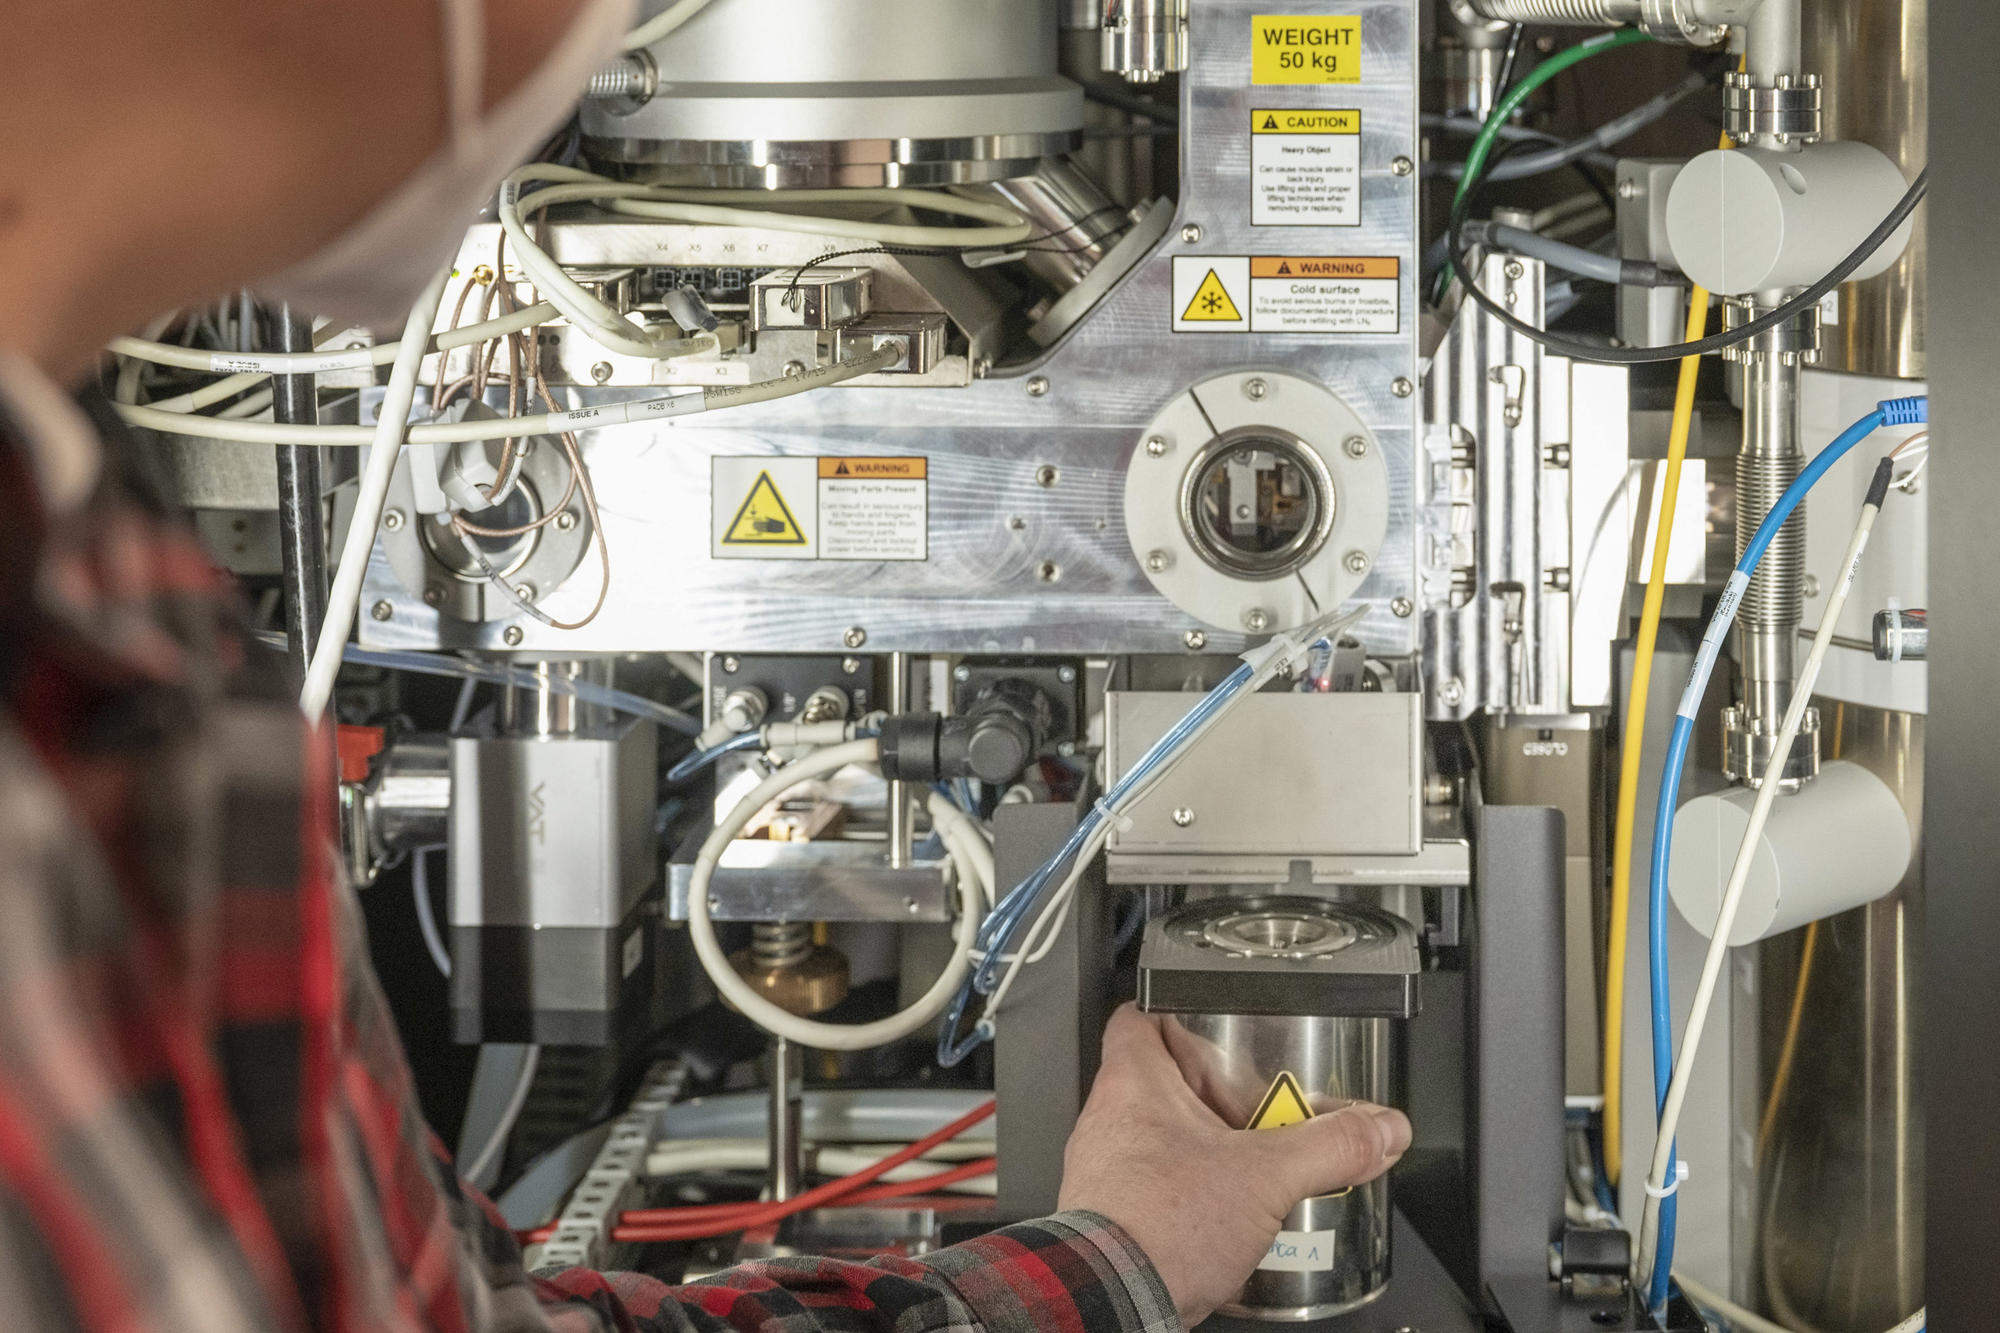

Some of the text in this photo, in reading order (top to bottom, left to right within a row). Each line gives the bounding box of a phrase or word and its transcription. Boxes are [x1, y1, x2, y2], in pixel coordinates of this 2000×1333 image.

[1263, 28, 1354, 45] WEIGHT
[1280, 51, 1336, 72] 50 kg
[1286, 117, 1348, 128] CAUTION
[1281, 146, 1331, 155] Heavy Object
[656, 243, 668, 251] X4
[756, 243, 769, 251] X7
[1300, 263, 1365, 274] WARNING
[1290, 284, 1360, 294] Cold surface
[715, 367, 728, 375] X3
[568, 409, 599, 420] ISSUE A
[854, 463, 910, 473] WARNING
